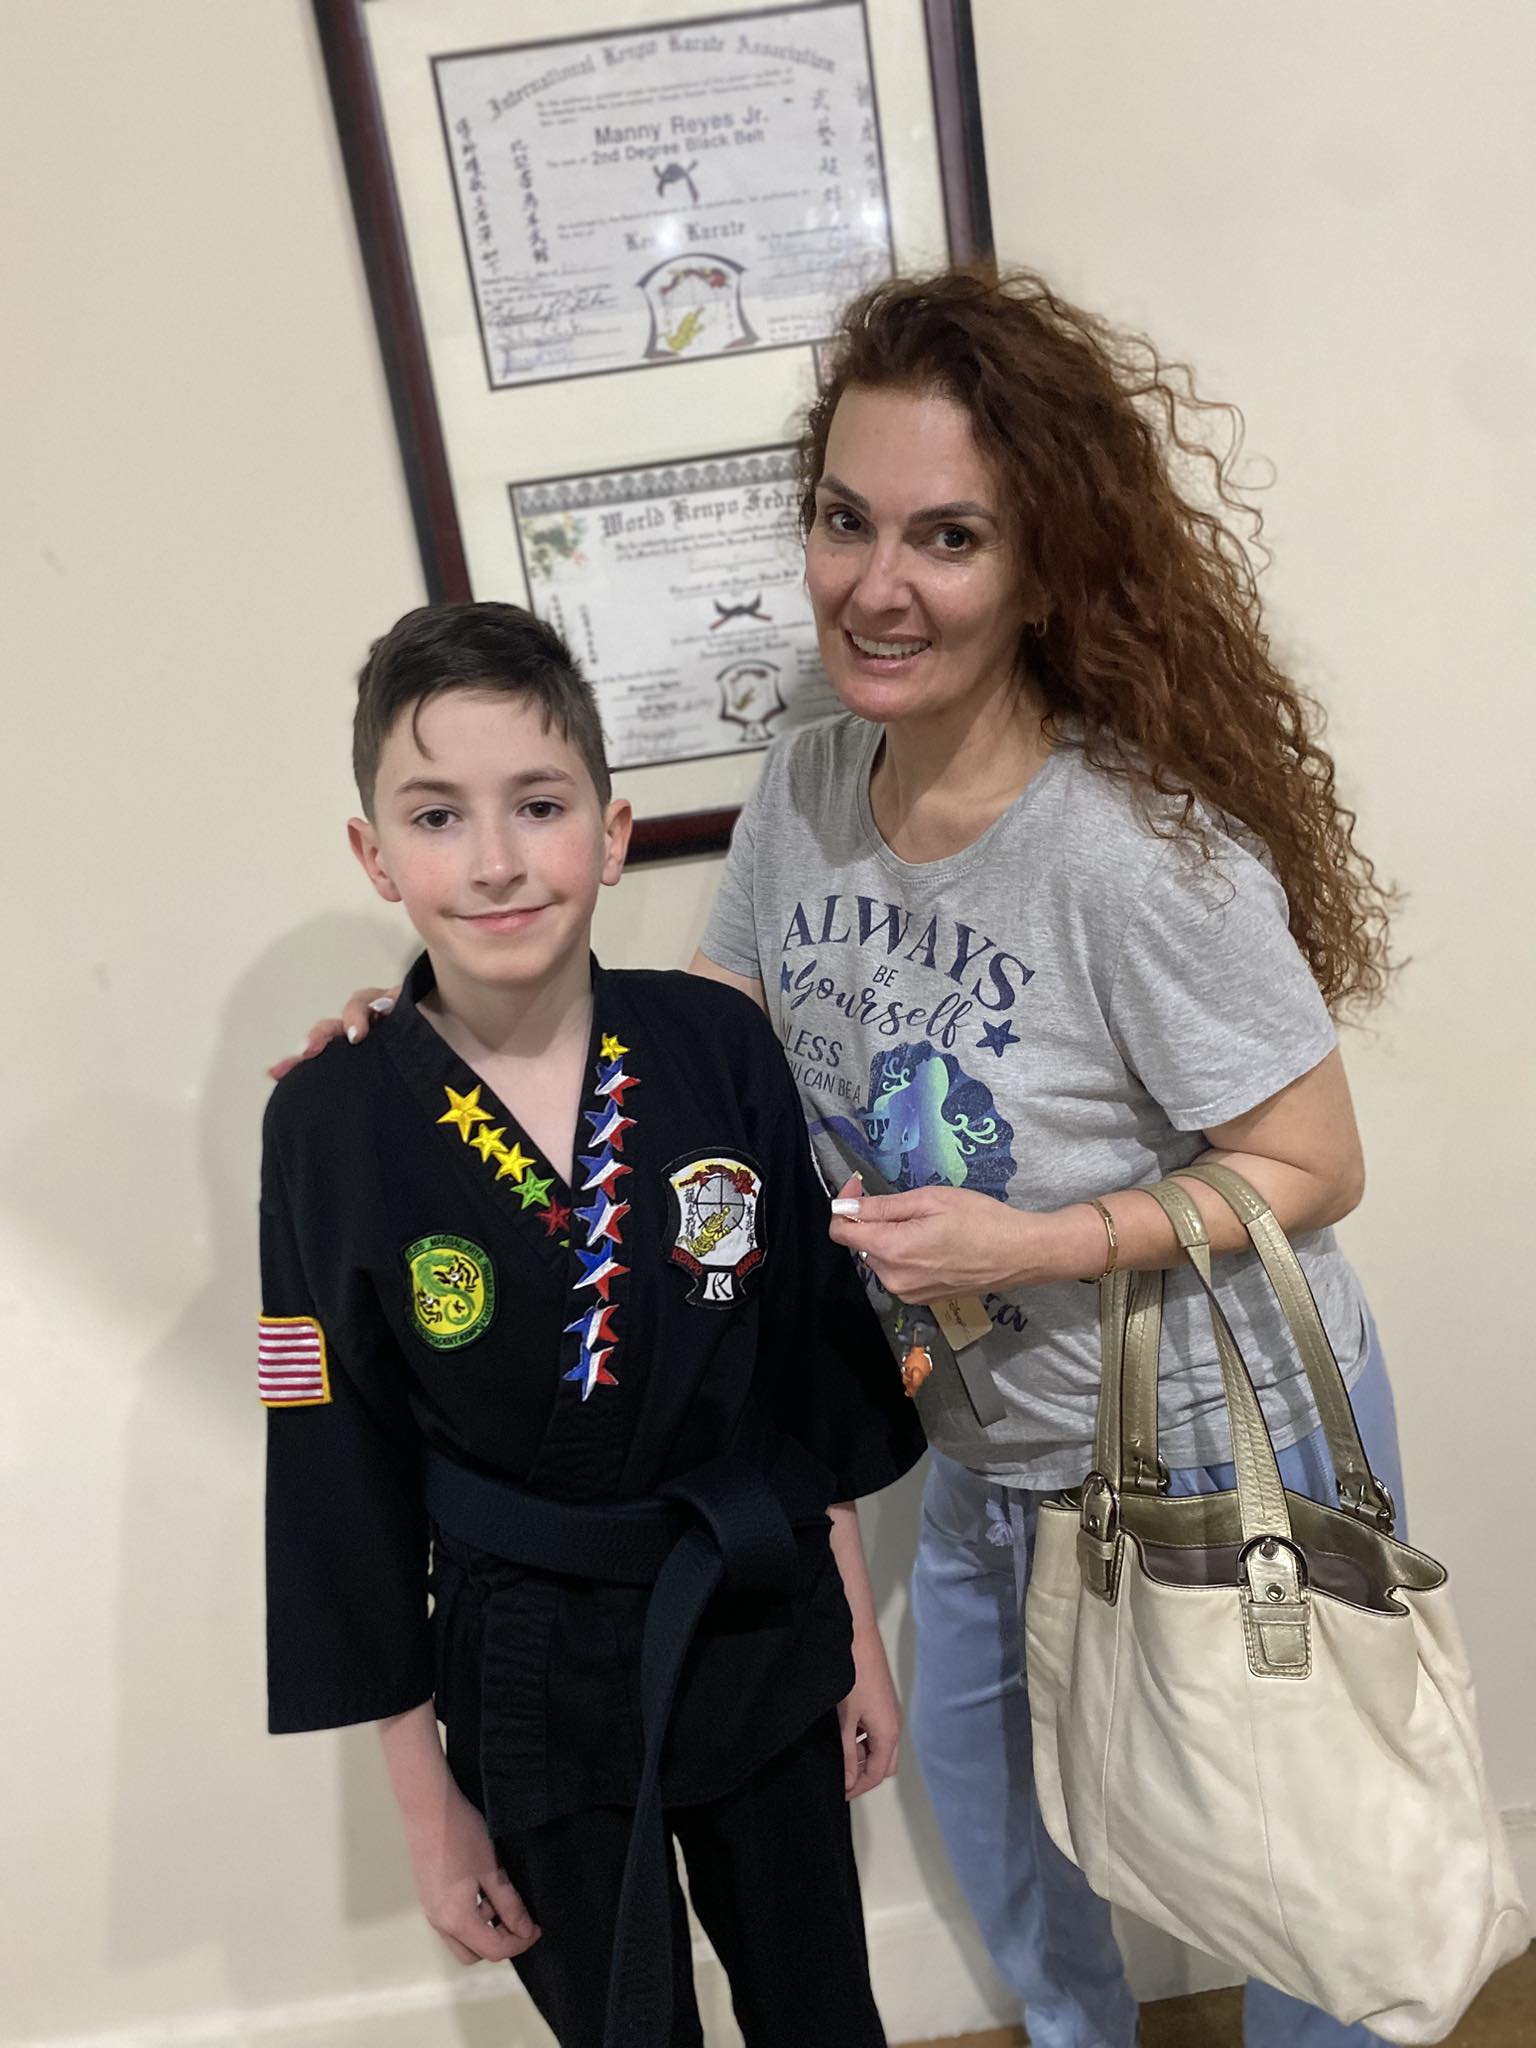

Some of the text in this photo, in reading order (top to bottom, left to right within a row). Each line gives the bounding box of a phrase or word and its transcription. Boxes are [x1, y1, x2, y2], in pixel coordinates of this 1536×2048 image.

[594, 105, 769, 146] Manny Reyes Jr.
[591, 149, 620, 166] 2nd
[625, 143, 680, 161] Degree
[685, 132, 729, 152] Black
[734, 128, 765, 146] Belt
[601, 507, 665, 542] World
[668, 497, 740, 530] Kenpo
[743, 487, 804, 520] Feder
[782, 894, 1035, 1012] ALWAYS
[872, 964, 899, 988] BE
[803, 1067, 836, 1094] CAN
[837, 1078, 853, 1100] BE
[853, 1084, 861, 1104] A
[453, 1299, 466, 1314] K
